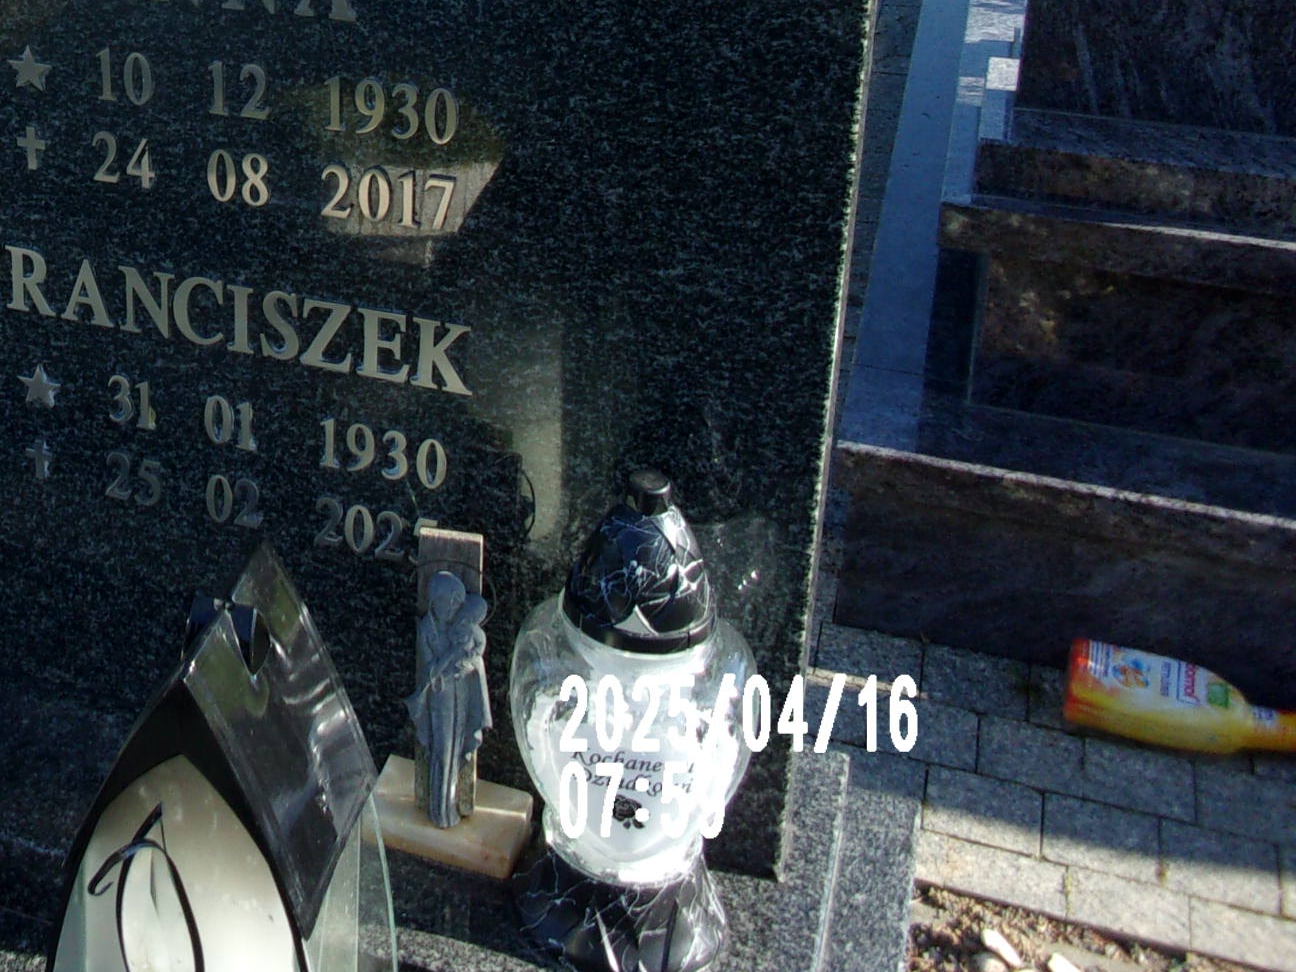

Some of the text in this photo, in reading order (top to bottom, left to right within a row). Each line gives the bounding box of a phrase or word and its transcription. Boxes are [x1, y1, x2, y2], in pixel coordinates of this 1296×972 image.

[95, 47, 459, 145] 10 12 1930
[91, 131, 456, 230] 24 08 2017
[107, 375, 447, 490] 31 01 1930
[105, 452, 439, 561] 25 02 202
